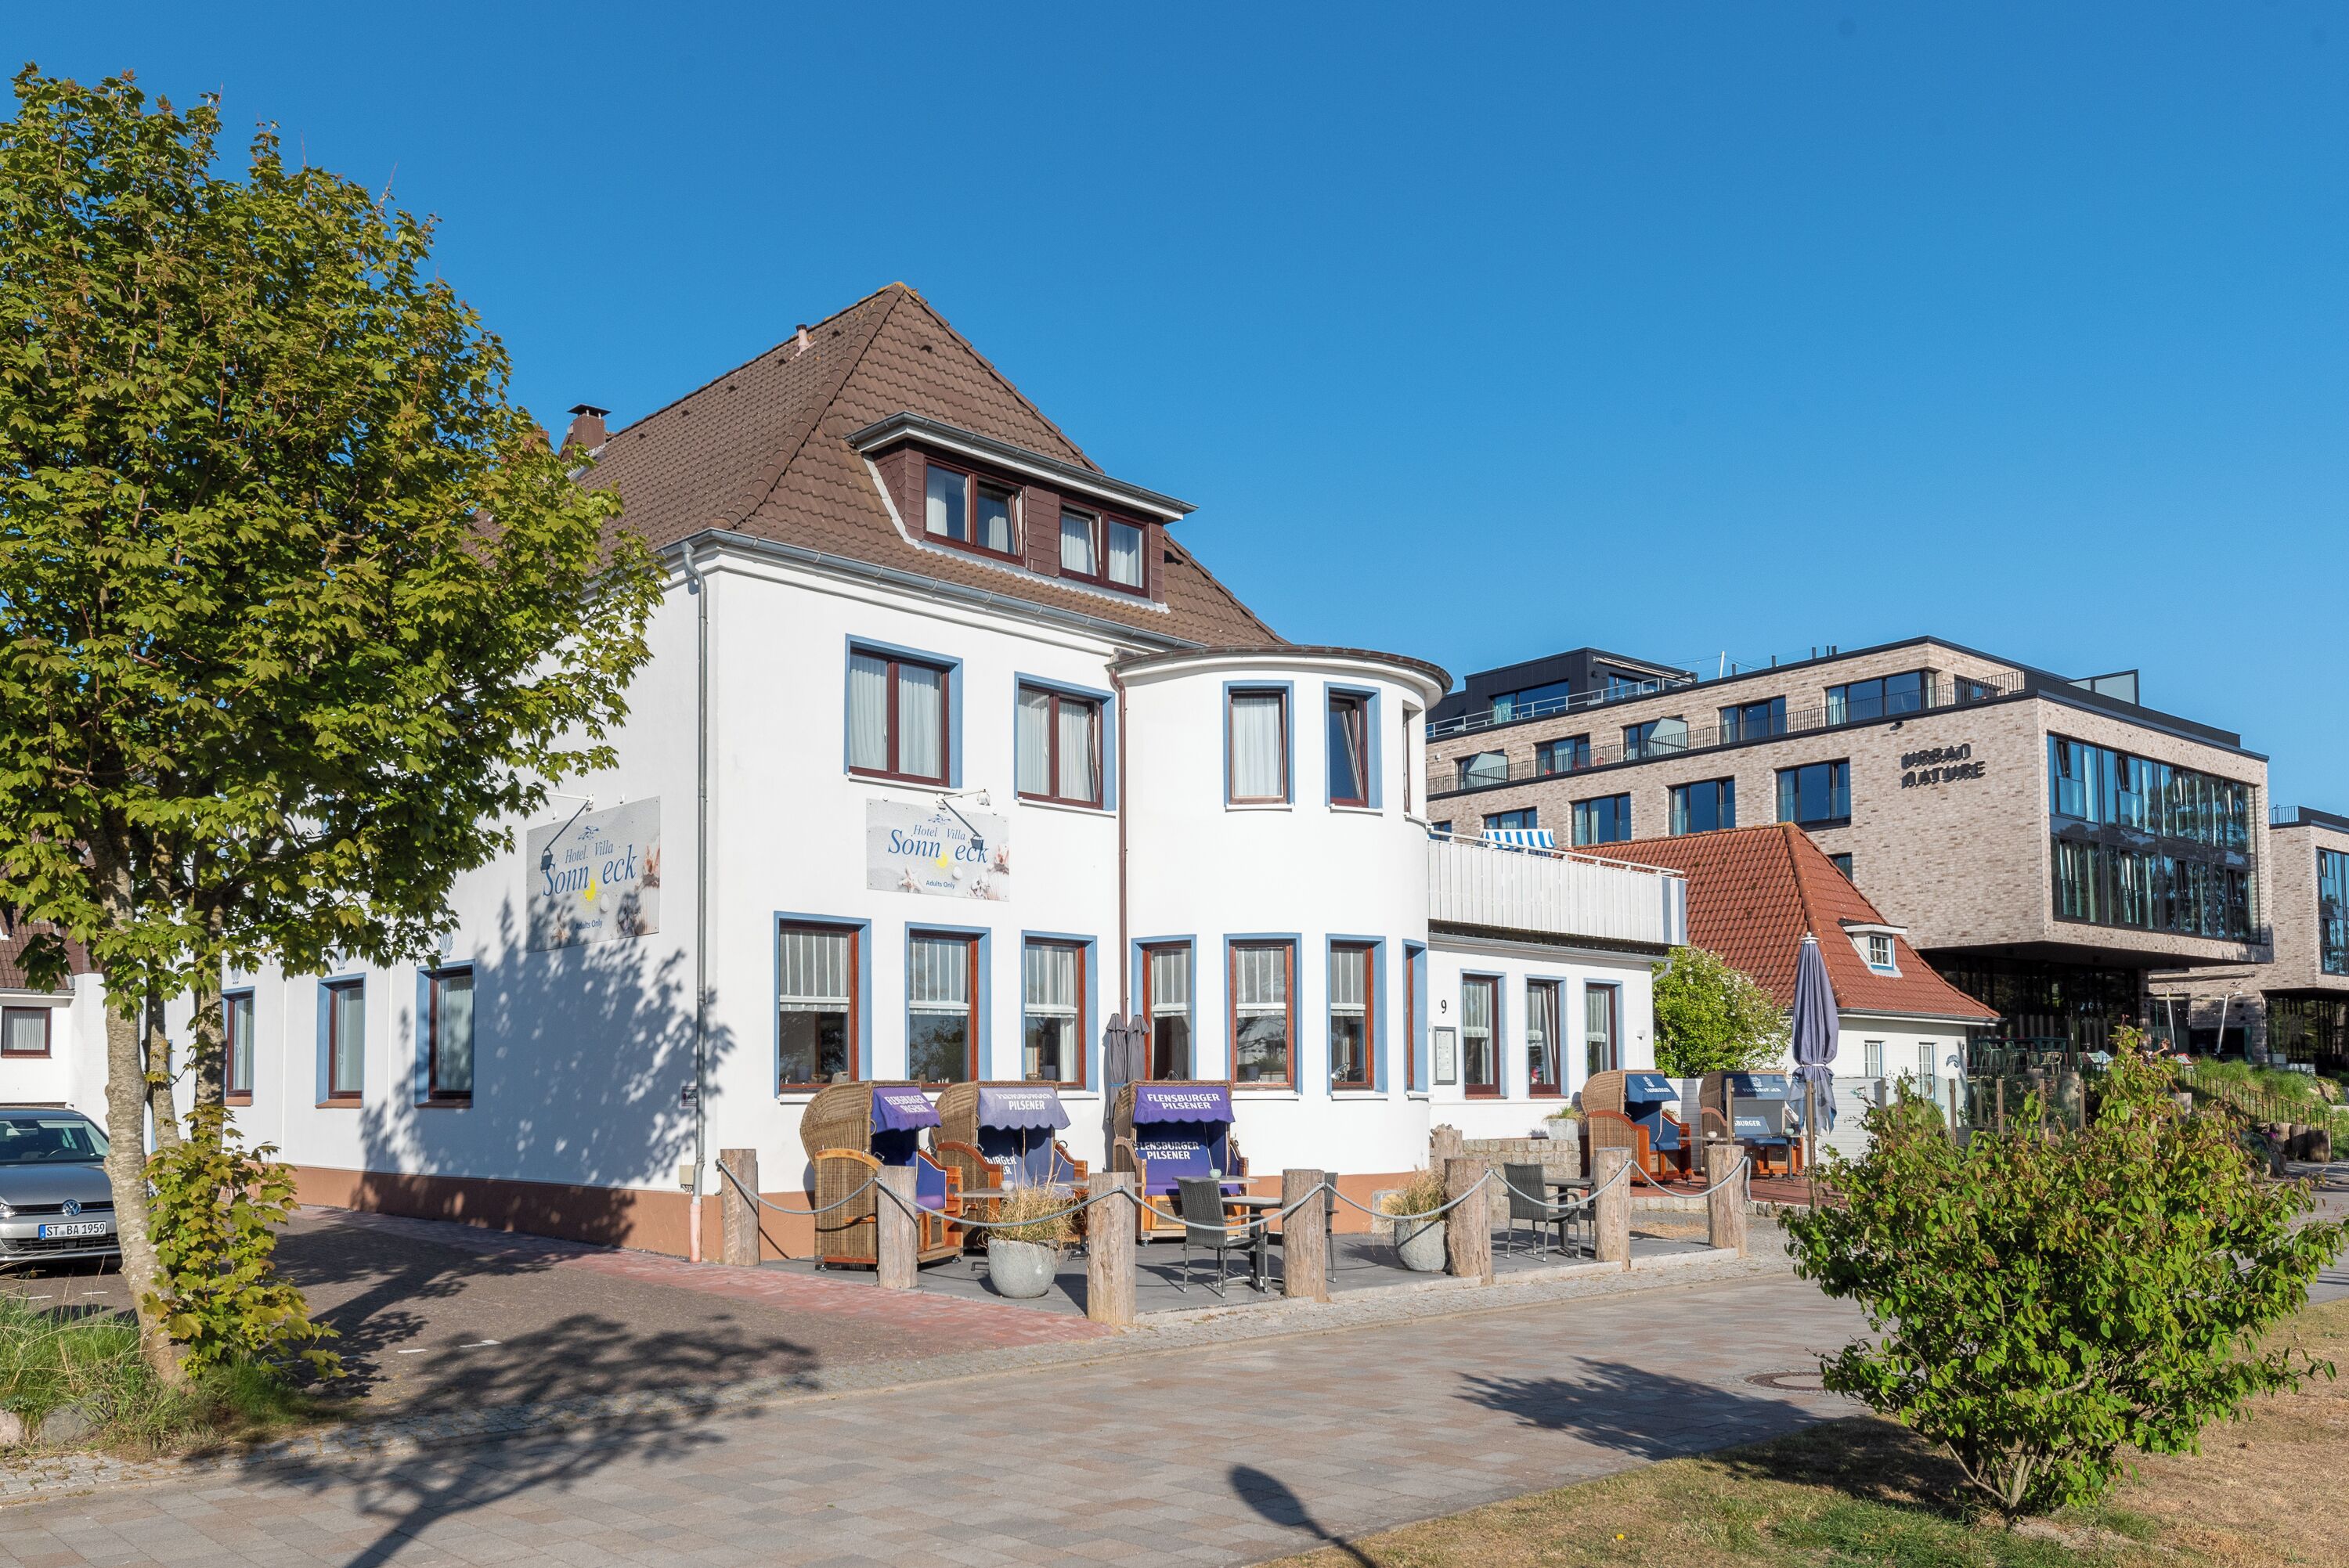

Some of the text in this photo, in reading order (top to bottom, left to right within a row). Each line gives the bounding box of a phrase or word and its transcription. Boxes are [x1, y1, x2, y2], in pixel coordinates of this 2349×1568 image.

[1901, 744, 1971, 770] URBAN
[1901, 760, 1986, 789] NATURE
[913, 824, 965, 840] Hotel Villa
[565, 840, 614, 863] Hotel Villa
[576, 919, 602, 930] Adults Only
[1441, 1000, 1447, 1014] 9
[1147, 1094, 1221, 1102] FLENSBURGER
[1009, 1100, 1045, 1110] PILSENER
[1147, 1151, 1191, 1159] PILSENER
[47, 1226, 59, 1236] ST
[67, 1225, 79, 1235] BA
[81, 1223, 105, 1235] 1959
